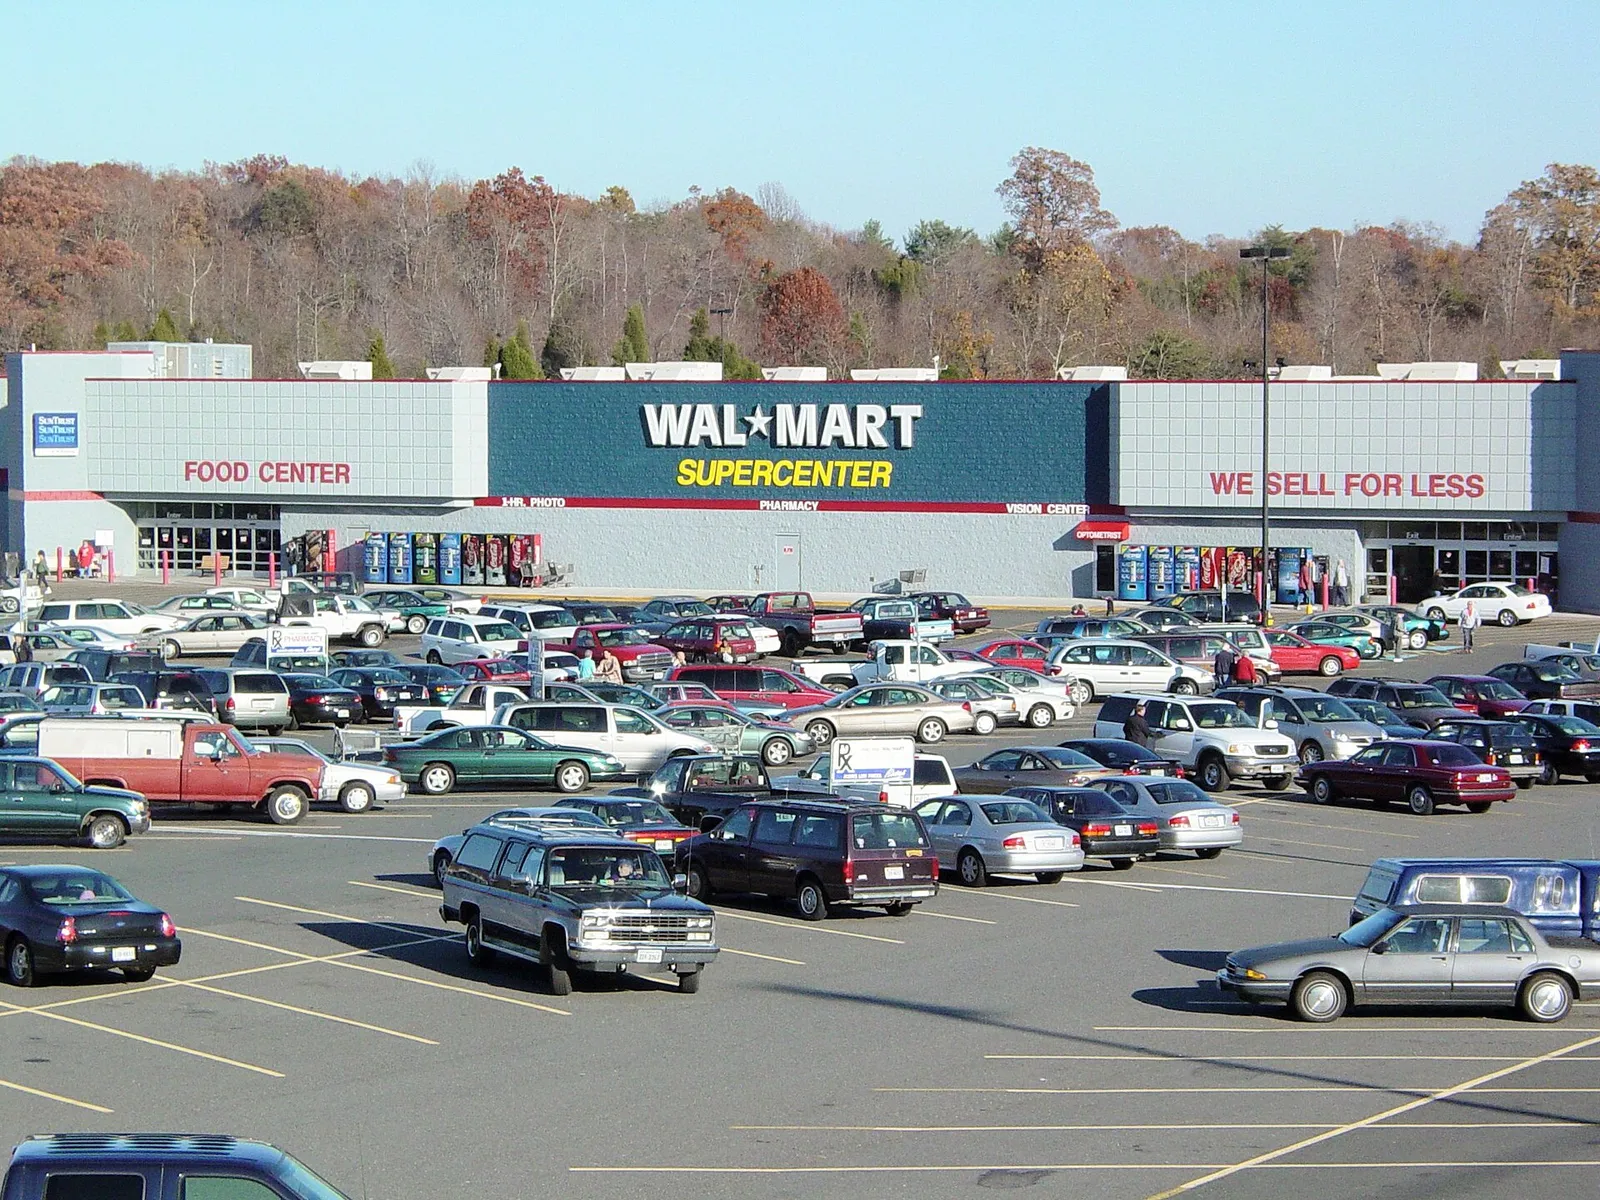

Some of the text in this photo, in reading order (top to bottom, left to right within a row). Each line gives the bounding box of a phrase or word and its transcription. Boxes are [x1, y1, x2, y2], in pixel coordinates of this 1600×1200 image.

[185, 461, 350, 484] FOOD CENTER
[677, 459, 893, 488] SUPERCENTER
[1210, 471, 1485, 498] WE SELL FOR LESS
[502, 497, 566, 507] 1-HR. PHOTO
[759, 500, 819, 511] PHARMACY
[1006, 503, 1090, 514] VISION CENTER
[1076, 531, 1122, 539] OPTOMETRIST
